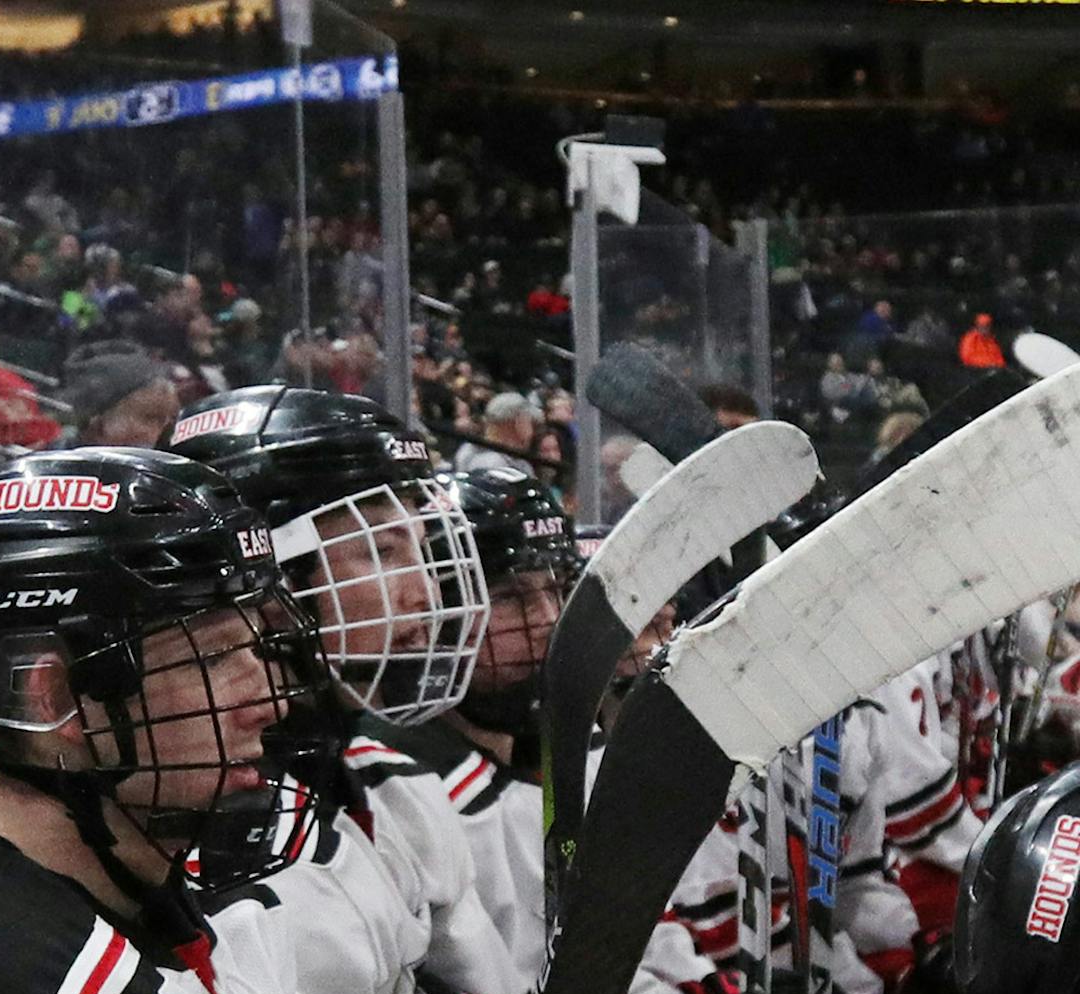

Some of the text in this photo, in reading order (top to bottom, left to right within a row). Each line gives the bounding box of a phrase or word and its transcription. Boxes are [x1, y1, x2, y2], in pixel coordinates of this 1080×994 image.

[523, 516, 563, 539] EAST
[808, 711, 840, 908] AUER
[1026, 814, 1080, 942] HOUNDS
